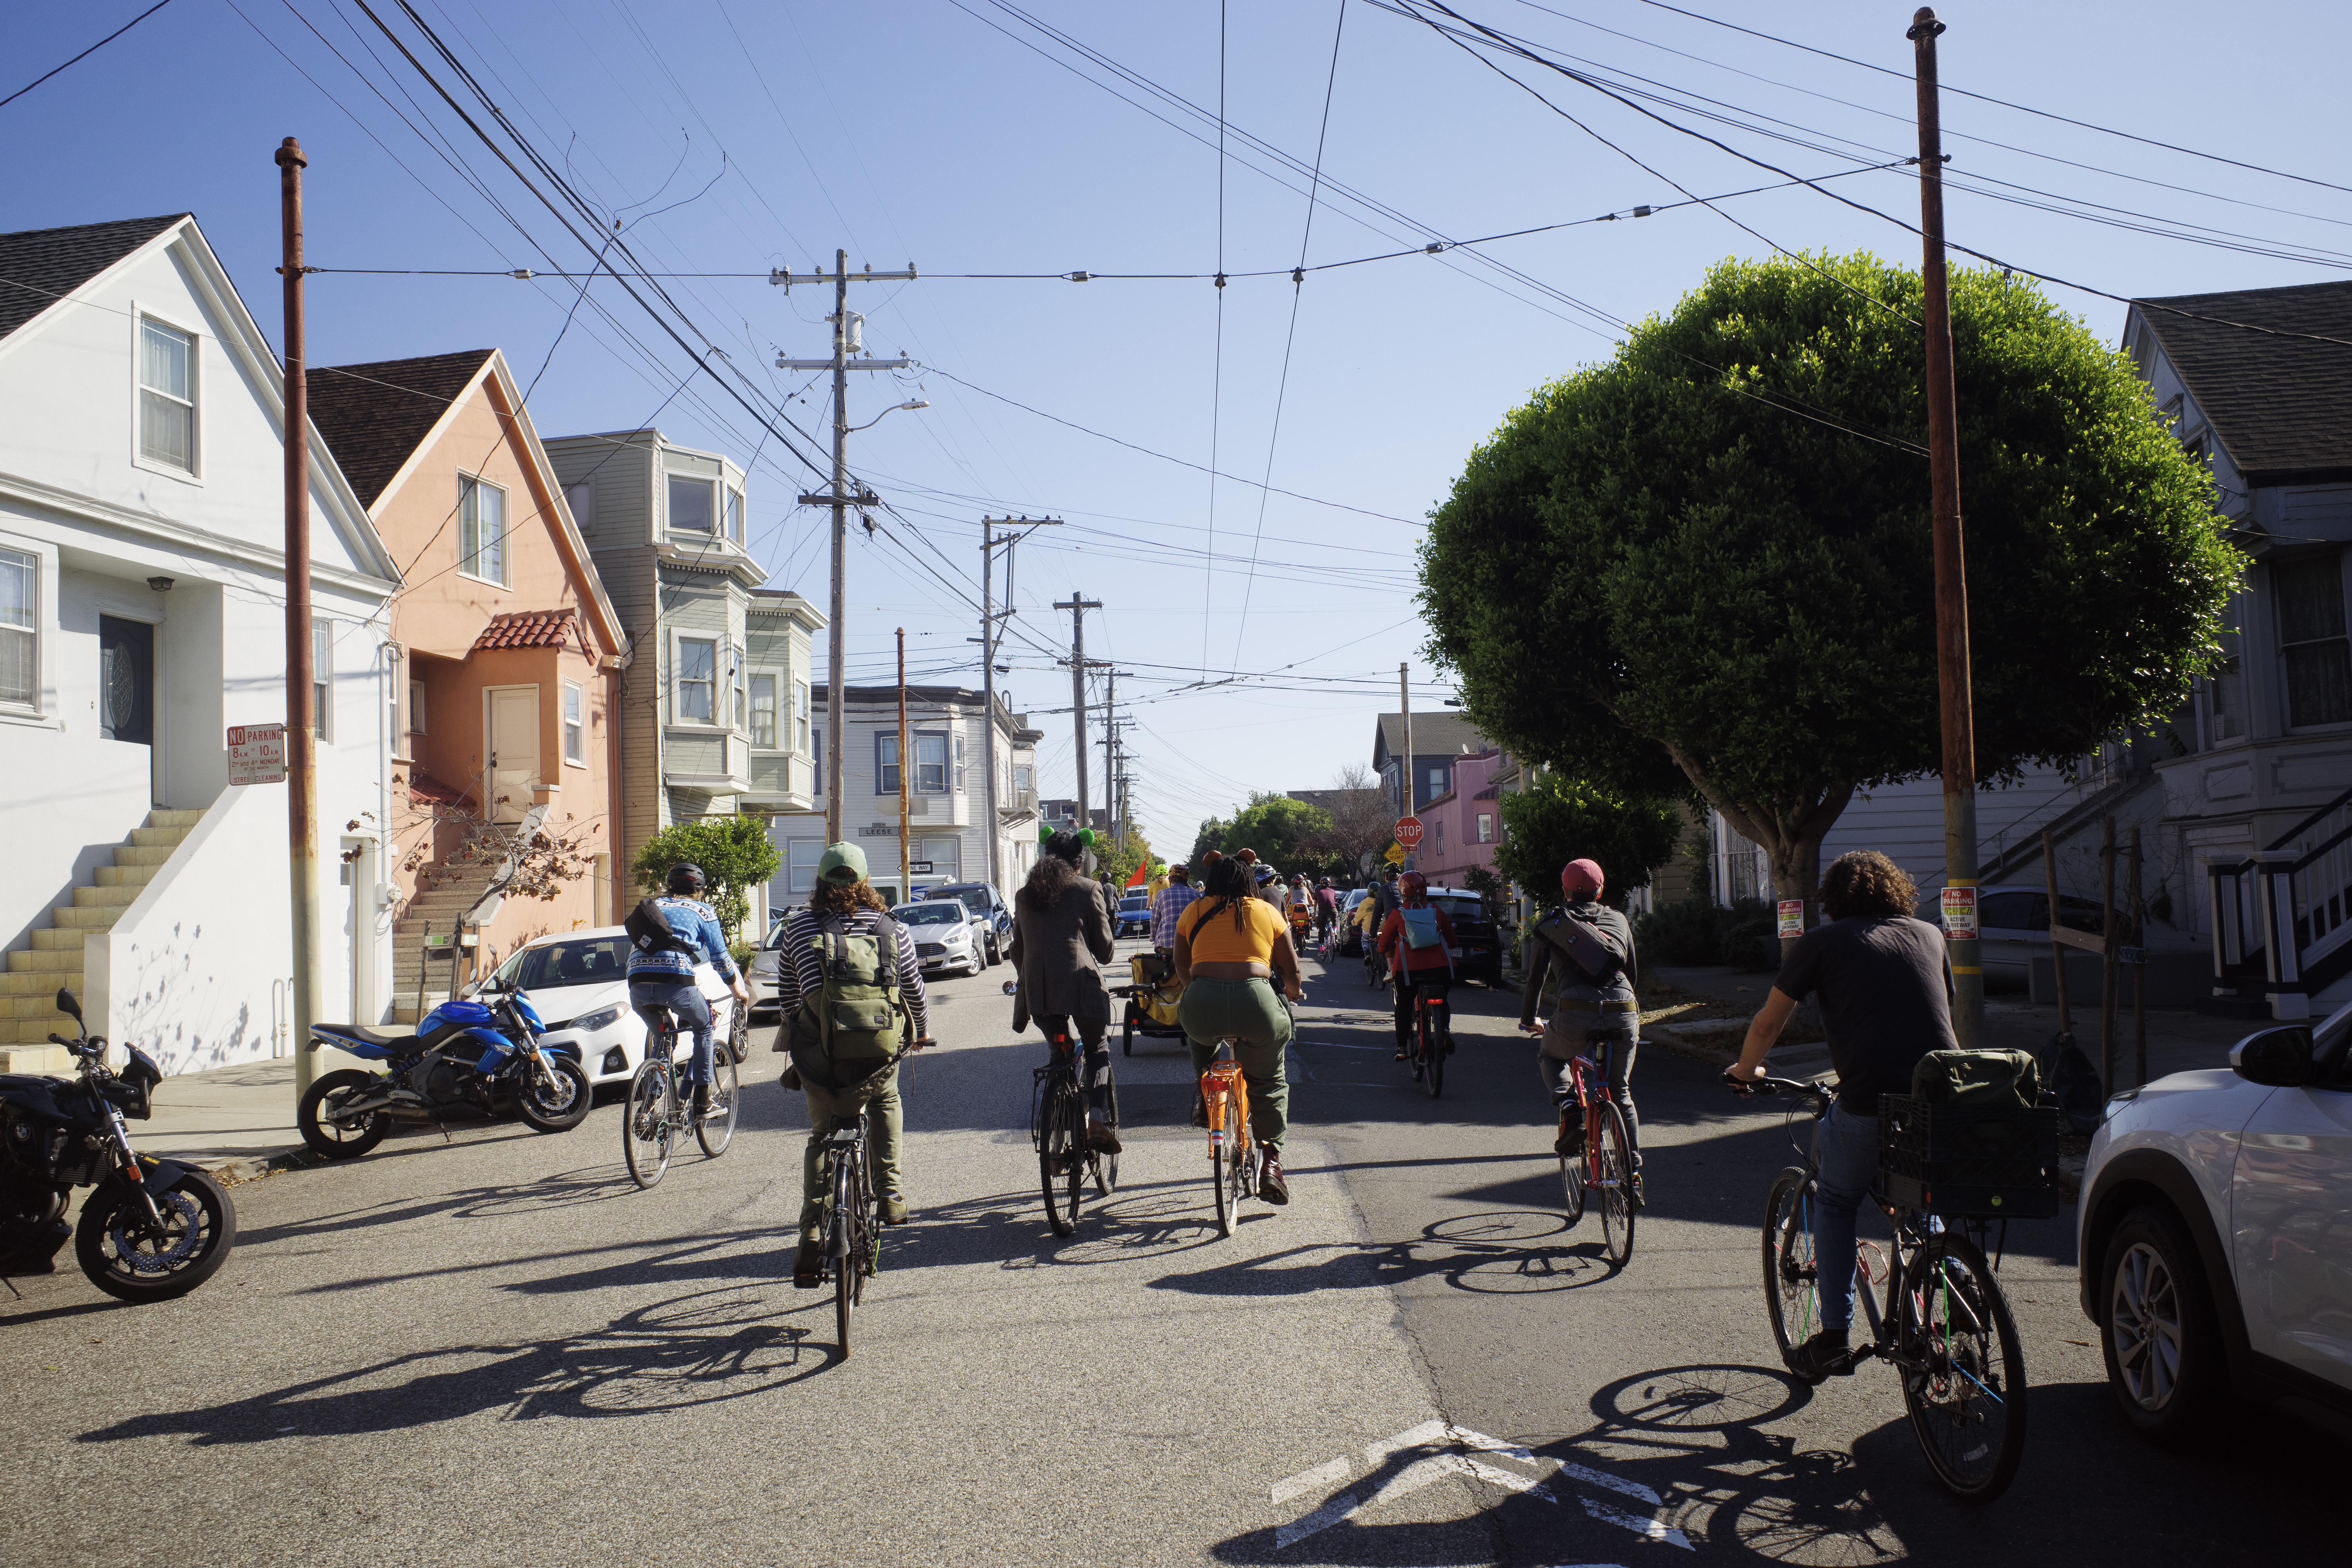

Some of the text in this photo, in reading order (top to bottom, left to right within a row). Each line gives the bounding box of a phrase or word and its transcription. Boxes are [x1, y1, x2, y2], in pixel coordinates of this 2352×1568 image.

[230, 729, 281, 744] NO PARKING
[260, 745, 269, 756] 10
[1397, 826, 1421, 837] STOP
